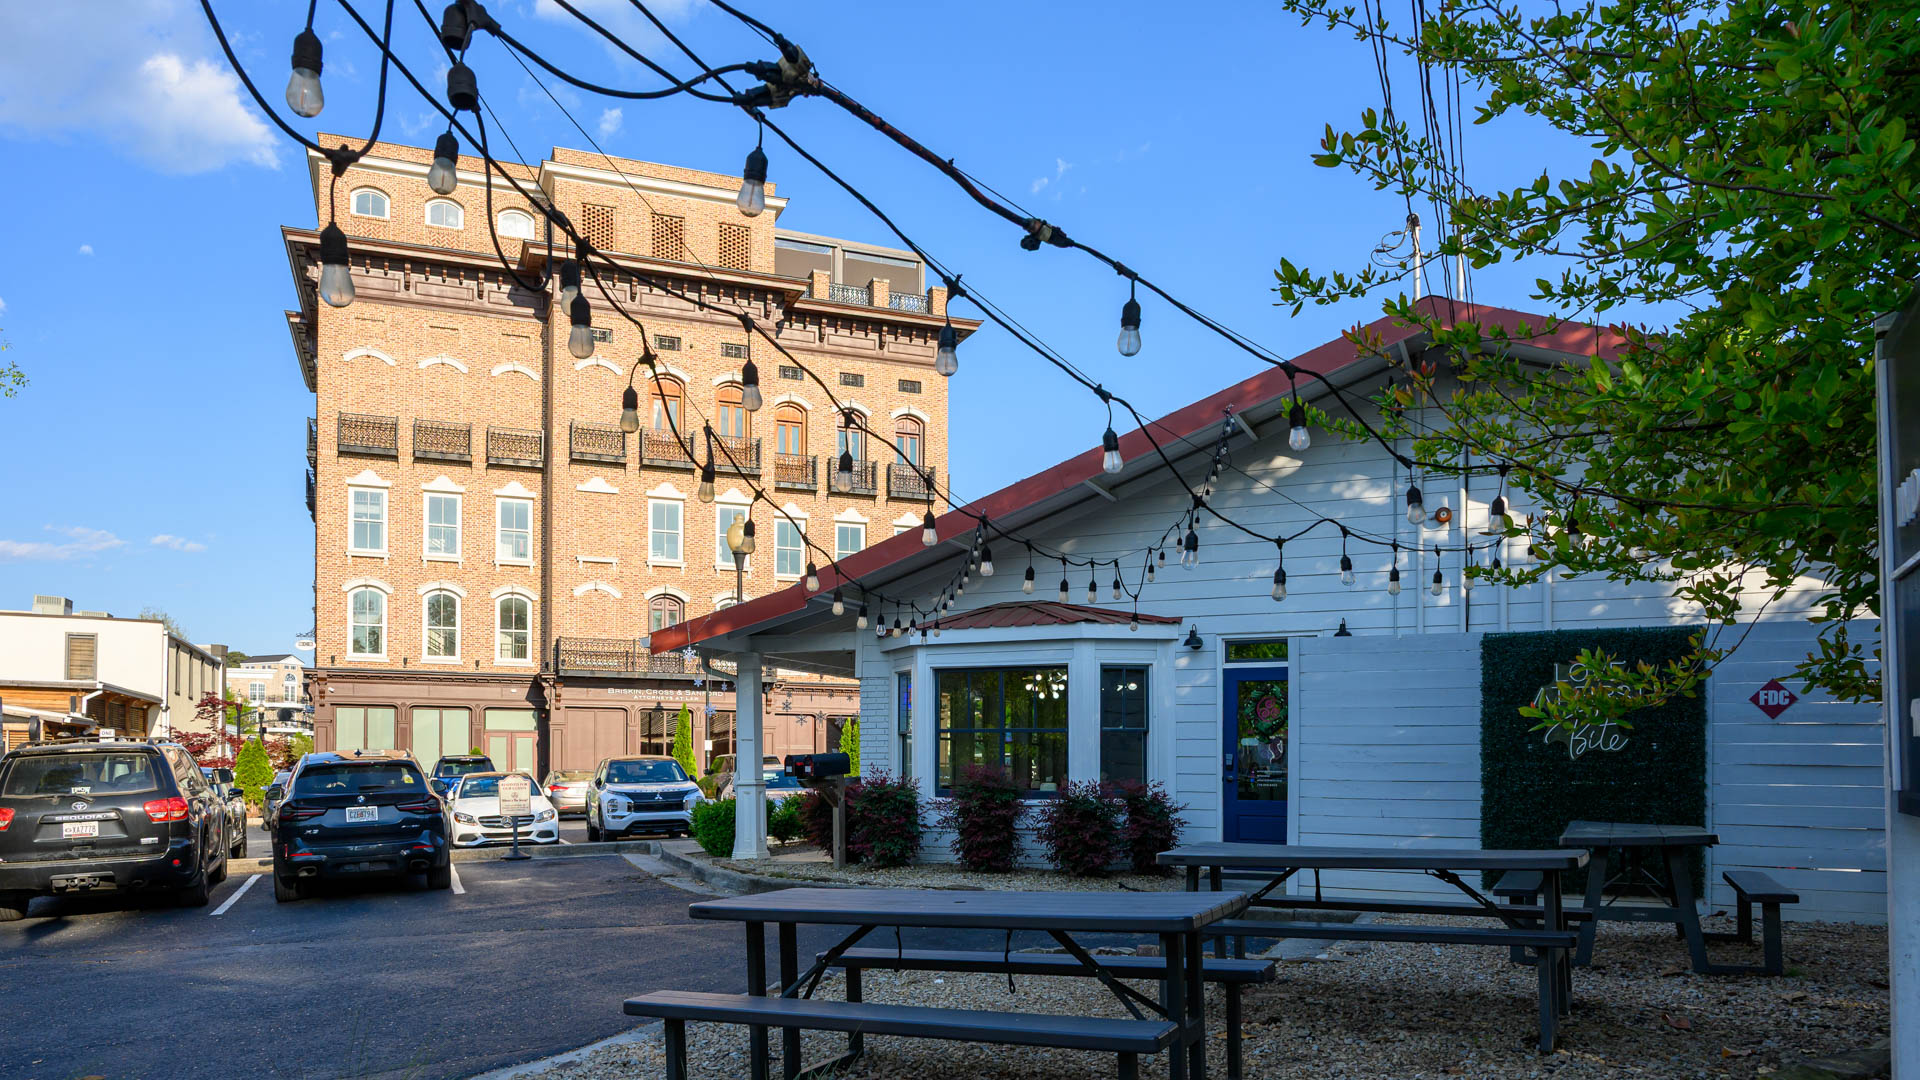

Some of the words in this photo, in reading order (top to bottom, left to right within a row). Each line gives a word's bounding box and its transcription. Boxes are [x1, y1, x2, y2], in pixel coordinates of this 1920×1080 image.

[607, 687, 644, 696] BRISKIN,
[645, 688, 675, 696] CROSS
[1759, 689, 1790, 706] FDC
